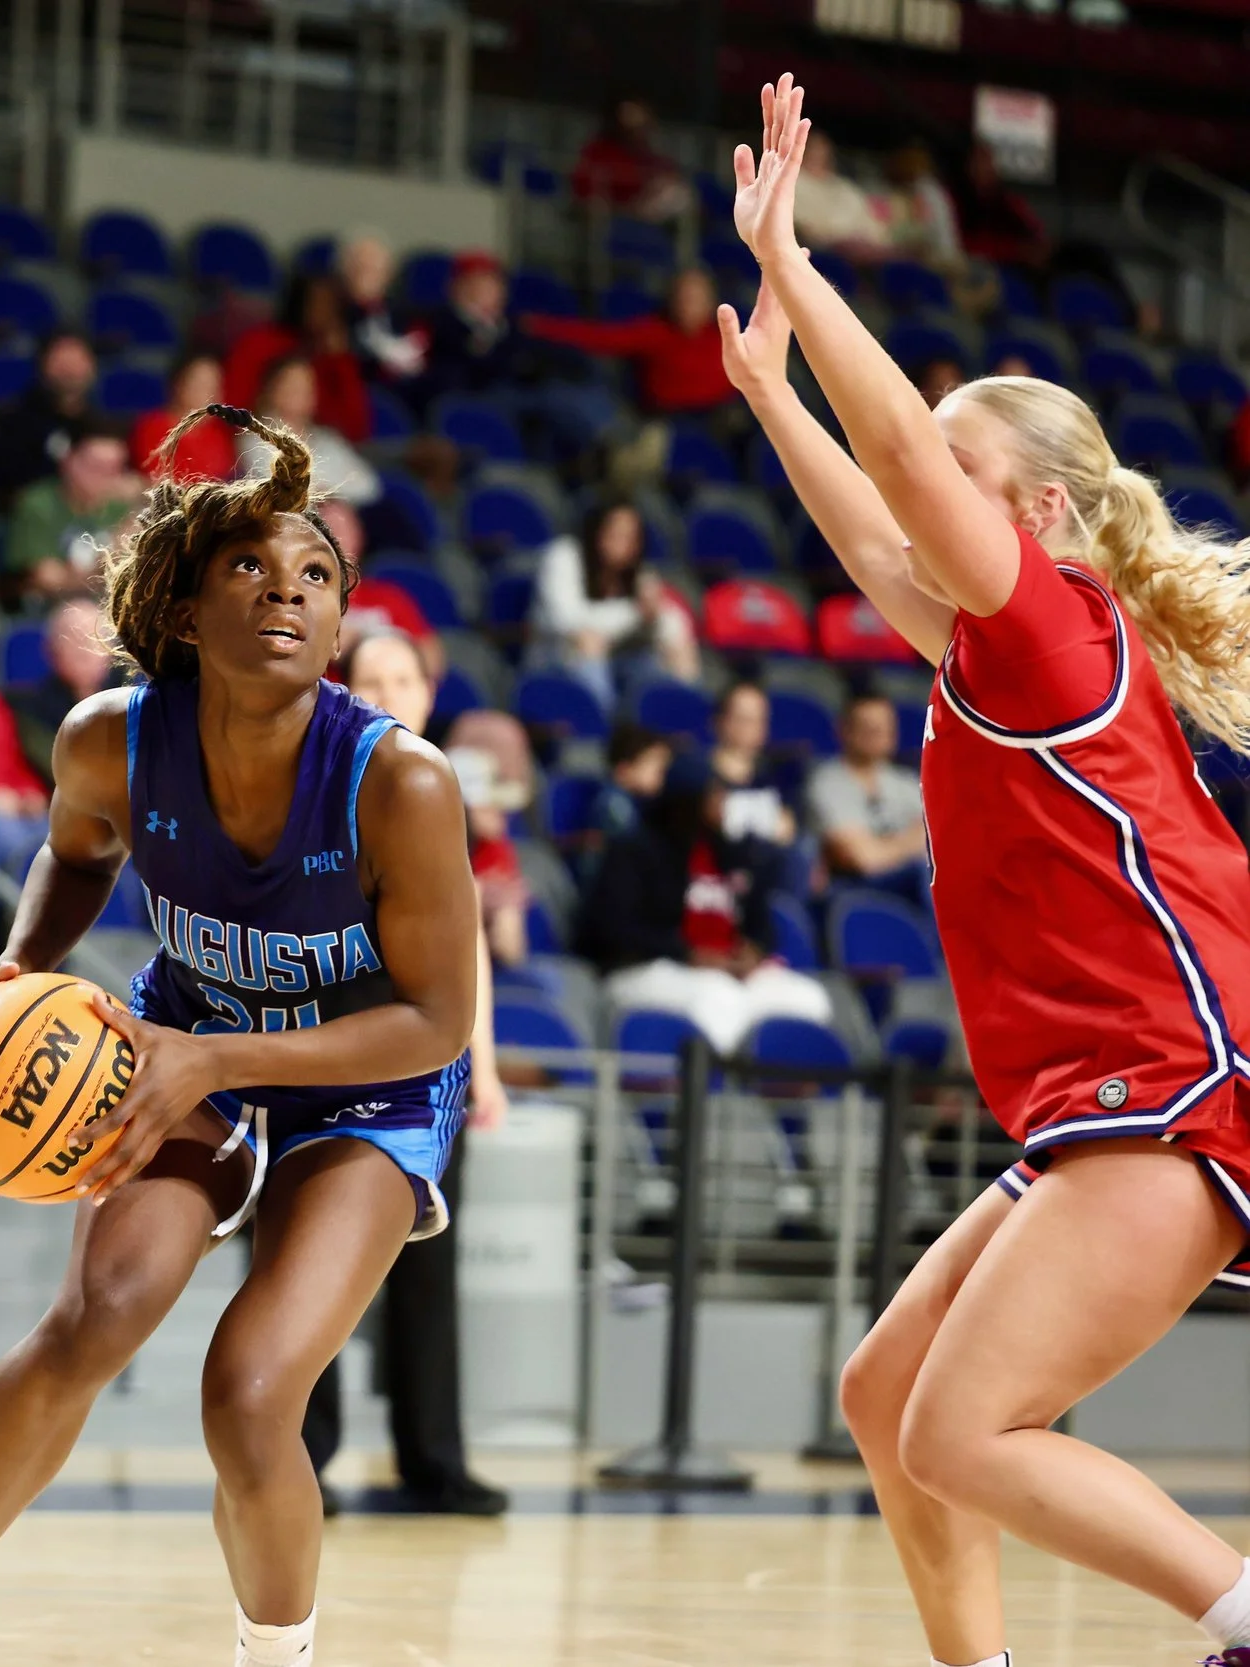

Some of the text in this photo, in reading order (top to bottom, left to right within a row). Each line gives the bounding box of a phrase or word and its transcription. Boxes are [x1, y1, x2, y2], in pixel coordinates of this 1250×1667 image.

[303, 850, 345, 876] PBC
[25, 1012, 53, 1052] OFFICIAL
[0, 1017, 82, 1130] NCAA
